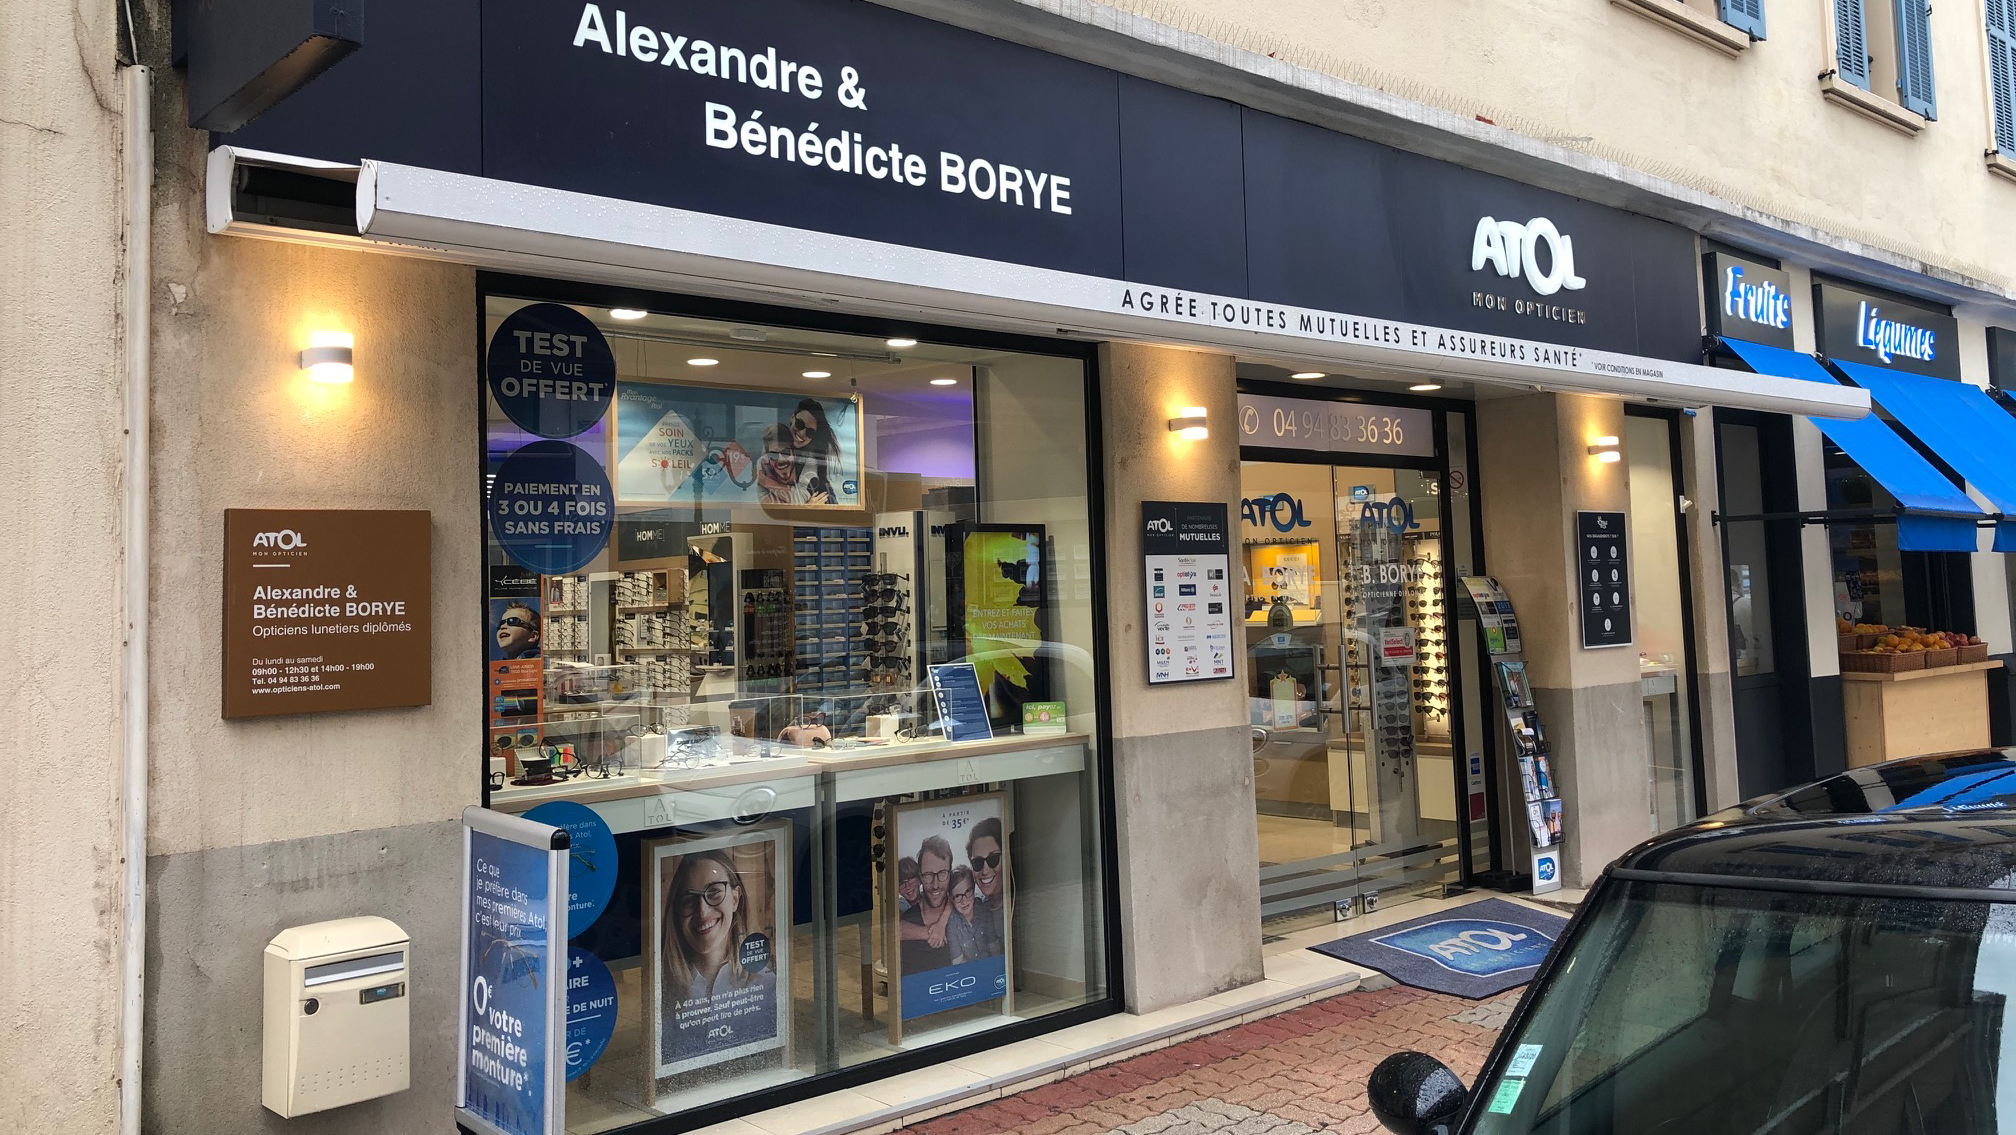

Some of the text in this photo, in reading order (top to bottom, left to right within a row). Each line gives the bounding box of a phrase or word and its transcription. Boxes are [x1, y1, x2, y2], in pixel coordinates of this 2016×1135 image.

[573, 3, 867, 111] Alexandre &
[704, 100, 1072, 215] Bénédicte BORYE
[1472, 216, 1587, 295] ATOL
[1725, 266, 1790, 329] Fruits
[1472, 291, 1587, 325] MON OPTICIEN
[1121, 289, 1198, 317] AGRÉE
[1210, 301, 1287, 329] TOUTES
[1299, 313, 1400, 343] MUTUELLES
[1411, 329, 1428, 347] ET
[1438, 333, 1525, 361] ASSUREURS
[1857, 300, 1936, 364] Légumes
[513, 329, 588, 358] TEST
[520, 359, 584, 376] DE VUE
[1606, 364, 1664, 378] CONDITIONS EN MAGASIN
[621, 392, 656, 403] Avantage
[659, 427, 684, 438] SOIN
[1273, 408, 1404, 445] 04 94 83 36 36
[667, 438, 694, 448] YEUX
[672, 449, 694, 457] PACKS
[504, 482, 601, 496] PAIEMENT EN
[497, 500, 607, 517] 3 OU 4 FOIS
[1241, 492, 1312, 533] ATOL
[1360, 497, 1420, 535] ATOL
[504, 520, 550, 535] SANS
[1147, 518, 1174, 533] ATOL
[253, 529, 307, 550] ATOL
[1180, 533, 1221, 541] MUTUELLES
[1264, 537, 1313, 545] OPTICIEN
[1262, 564, 1317, 586] BORYE
[1363, 564, 1424, 584] B. BORYE
[253, 584, 358, 600] Alexandre &
[253, 602, 405, 619] Bénédicte BORYE
[972, 608, 1034, 618] ENTREZ ET FAITES
[252, 621, 411, 638] Opticiens lunetiers diplômés
[982, 620, 1027, 629] VOS ACHATS
[265, 657, 284, 665] lundi
[296, 656, 324, 664] samedi
[252, 668, 278, 676] 09h00
[284, 666, 309, 675] 12h30
[321, 664, 345, 672] 14h00
[351, 663, 374, 671] 19h00
[252, 677, 266, 685] Tel.
[278, 676, 288, 684] 94
[300, 675, 310, 683] 36
[251, 683, 341, 695] www.opticiens-atol.com
[948, 810, 970, 818] PARTIR
[579, 821, 597, 829] dans
[476, 858, 500, 878] Ce que
[1540, 862, 1555, 873] ATOL
[475, 875, 528, 906] je préfère dans
[476, 895, 491, 910] mes
[492, 899, 527, 924] premières
[475, 911, 492, 927] c'est
[492, 916, 508, 933] leur
[745, 939, 766, 950] TEST
[1428, 928, 1528, 961] ATOL
[928, 976, 976, 995] EKO
[682, 999, 693, 1008] 40
[694, 996, 711, 1006] ans,
[711, 994, 721, 1002] on
[721, 990, 733, 999] n'a
[734, 987, 750, 1000] plus
[750, 983, 764, 993] rien
[572, 996, 615, 1014] DE NUIT
[675, 994, 764, 1020] à prouver. Sauf peut-être
[489, 1006, 522, 1038] votre
[679, 1005, 762, 1030] qu'on peut lire de près.
[573, 1027, 587, 1037] DE
[708, 1024, 734, 1038] ATOL
[472, 1024, 527, 1067] première
